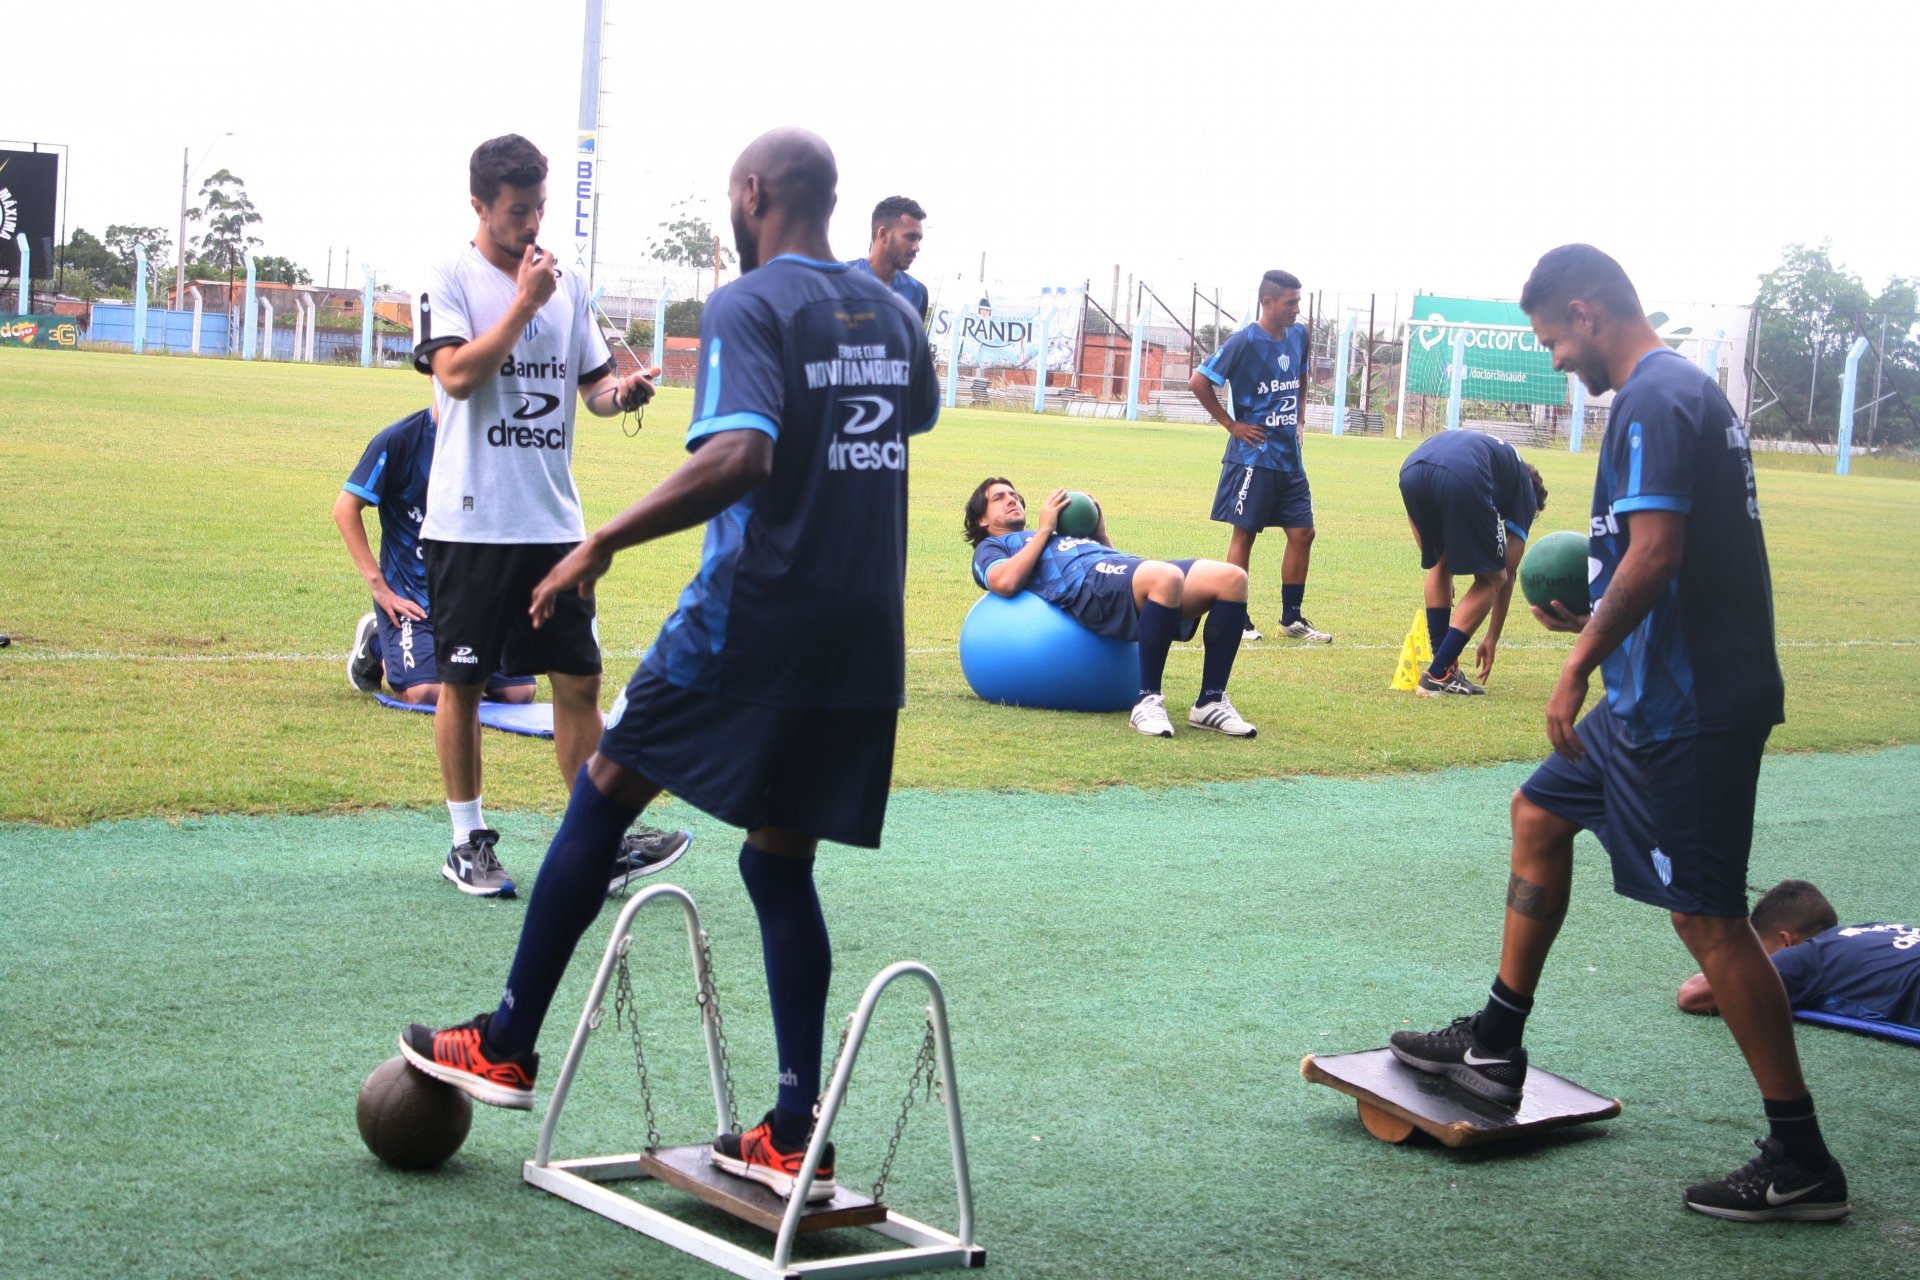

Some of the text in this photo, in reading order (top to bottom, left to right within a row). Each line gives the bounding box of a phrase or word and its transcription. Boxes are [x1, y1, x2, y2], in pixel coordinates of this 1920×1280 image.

[575, 161, 593, 238] BELL
[0, 188, 18, 240] MÁXIMA
[49, 324, 76, 345] 3G
[936, 310, 1033, 346] SRANDI
[1265, 411, 1297, 427] dres
[450, 654, 478, 665] dresch
